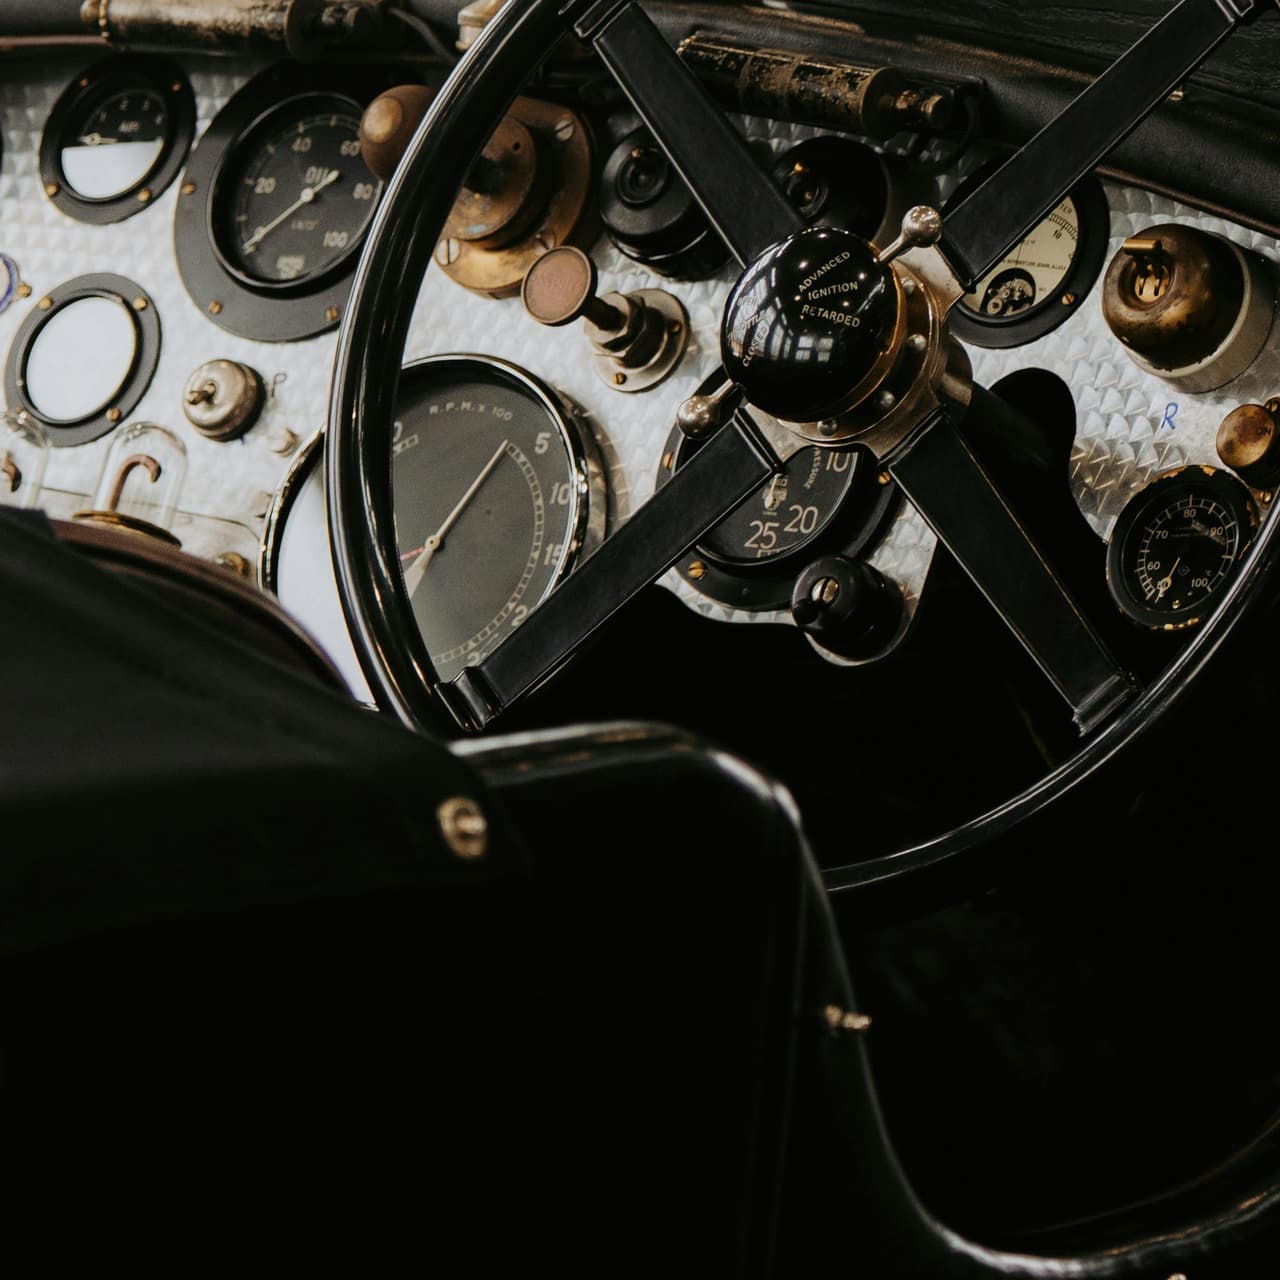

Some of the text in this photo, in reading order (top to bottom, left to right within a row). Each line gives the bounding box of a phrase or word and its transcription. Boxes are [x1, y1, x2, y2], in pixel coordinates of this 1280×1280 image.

[291, 137, 312, 152] 40
[340, 140, 361, 156] 60
[254, 177, 276, 194] 20
[353, 182, 374, 200] 80
[323, 231, 349, 248] 100
[798, 251, 851, 293] ADVANCED
[808, 281, 859, 301] IGNITION
[801, 304, 861, 328] RETARDED
[742, 325, 769, 367] CLOSED
[492, 406, 513, 421] 100
[1161, 402, 1179, 430] R
[1256, 426, 1272, 436] ON
[534, 431, 551, 455] 5
[826, 451, 851, 472] 10
[549, 482, 569, 505] 10
[784, 504, 818, 534] 20
[1183, 508, 1197, 518] 80
[744, 520, 780, 550] 25
[1155, 529, 1169, 539] 70
[1210, 526, 1224, 537] 90
[543, 543, 563, 566] 15
[1147, 561, 1161, 571] 60
[1191, 578, 1209, 588] 100
